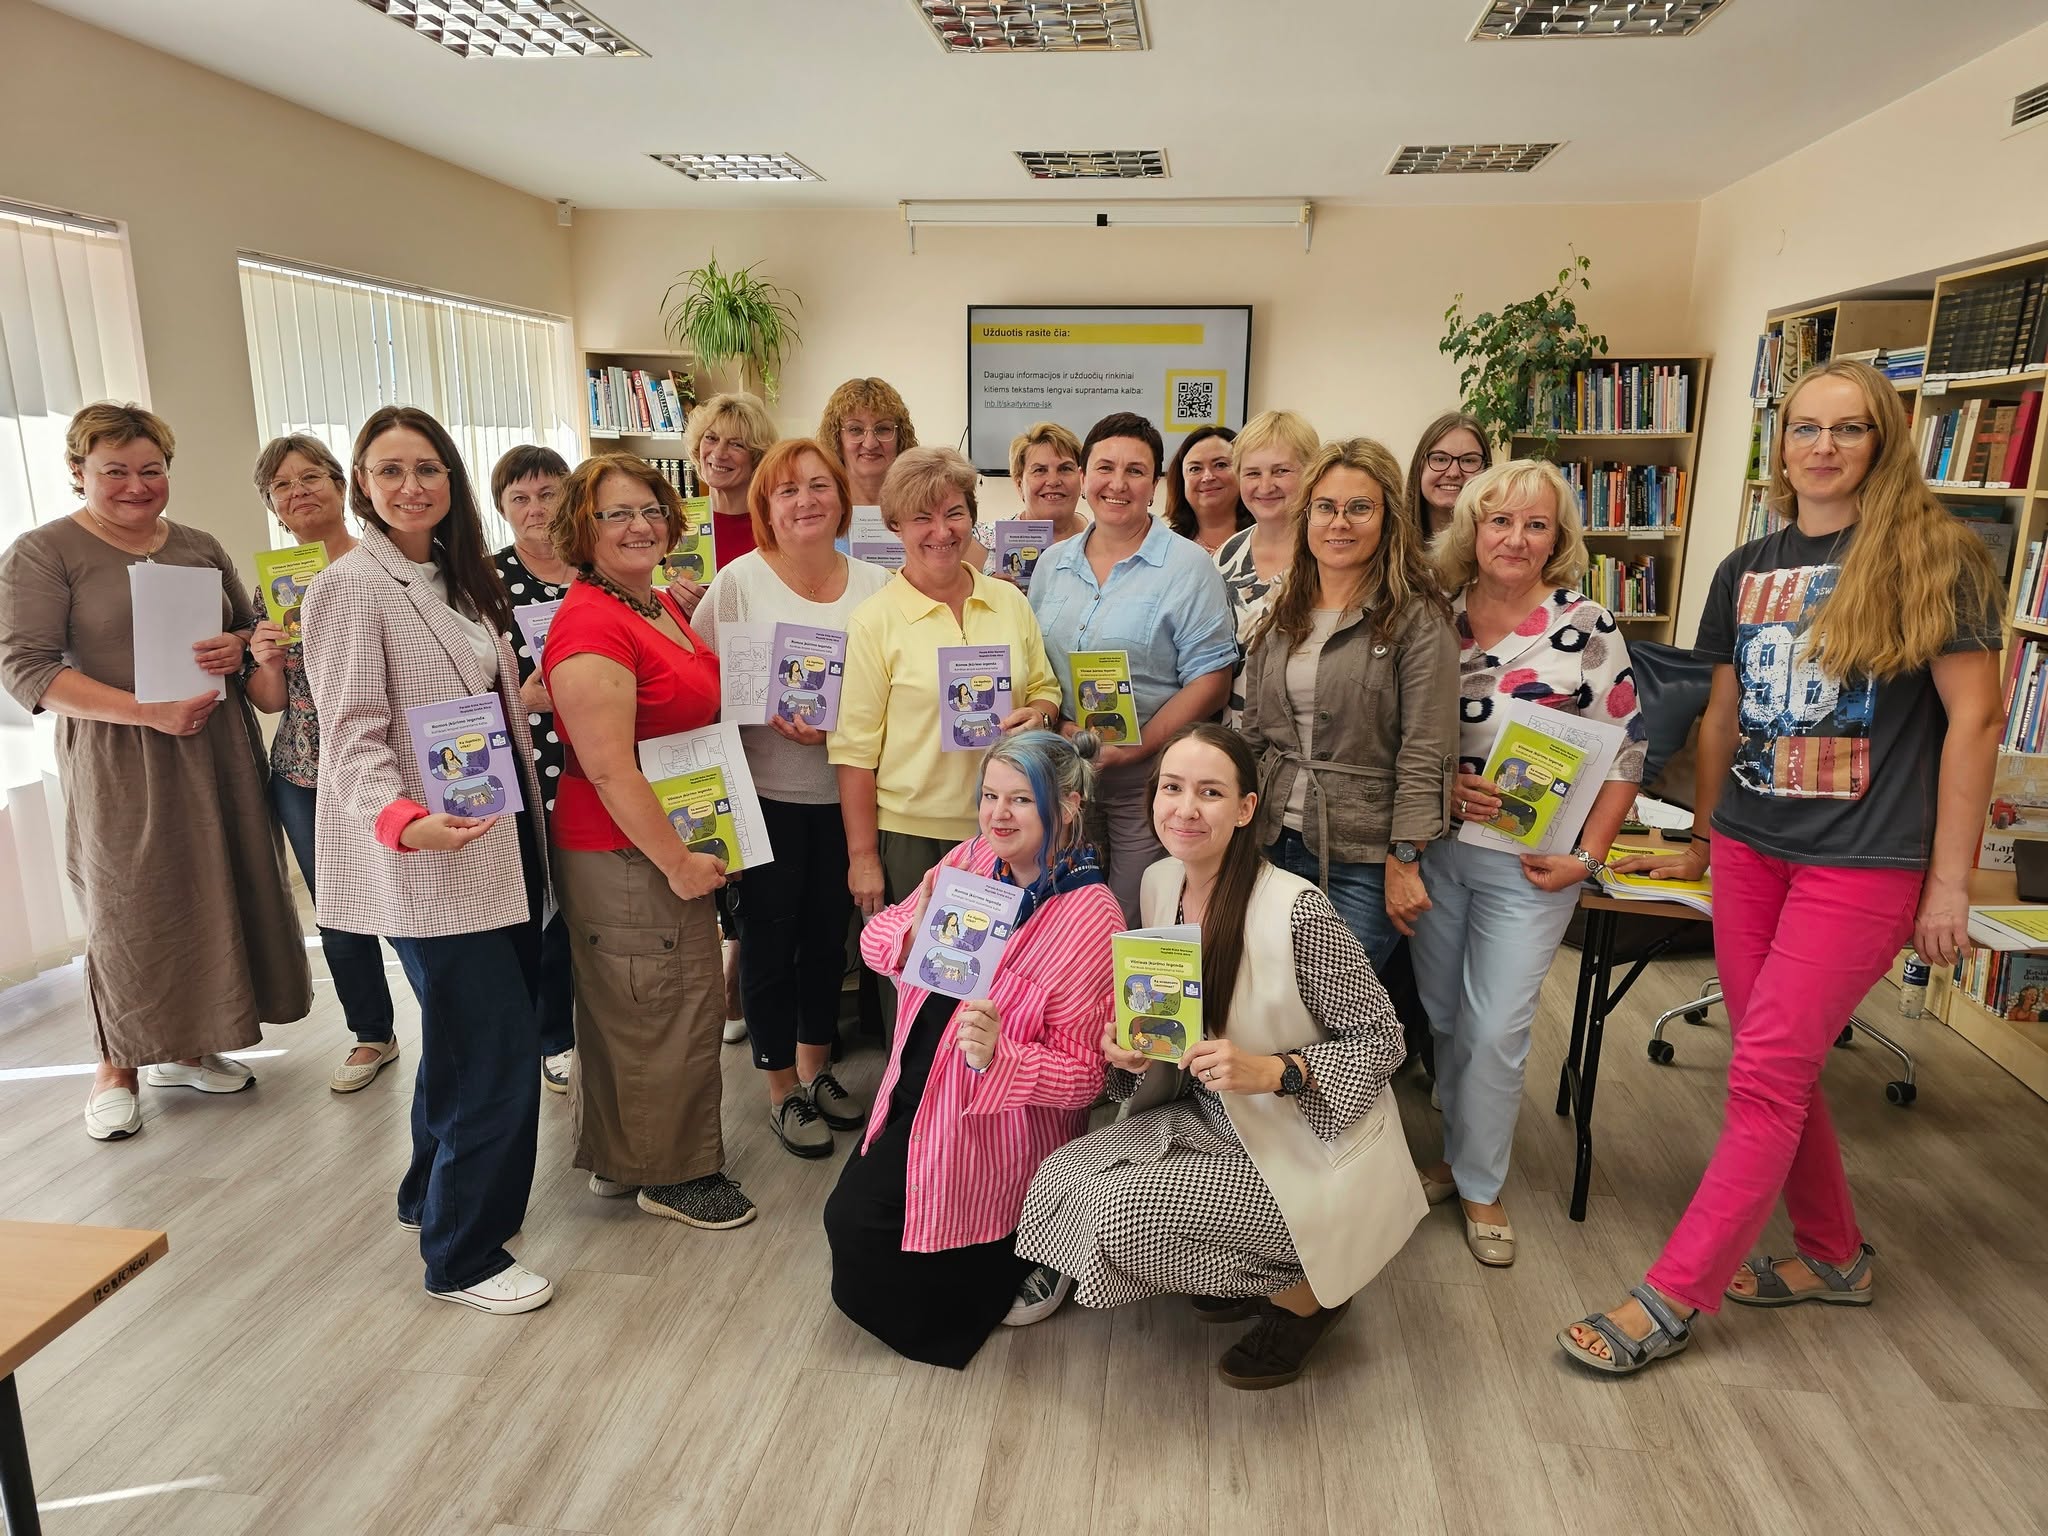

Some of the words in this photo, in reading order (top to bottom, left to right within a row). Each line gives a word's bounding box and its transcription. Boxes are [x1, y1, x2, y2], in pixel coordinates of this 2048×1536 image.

[983, 327, 1023, 337] Užduotis
[1025, 328, 1051, 337] rasite
[1053, 328, 1070, 337] čia:
[984, 371, 1015, 380] Daugiau
[1017, 371, 1061, 380] informacijos
[1070, 371, 1103, 380] užduočių
[984, 385, 1009, 393] kitiems
[1047, 386, 1073, 395] lengvai
[1075, 387, 1119, 395] suprantama
